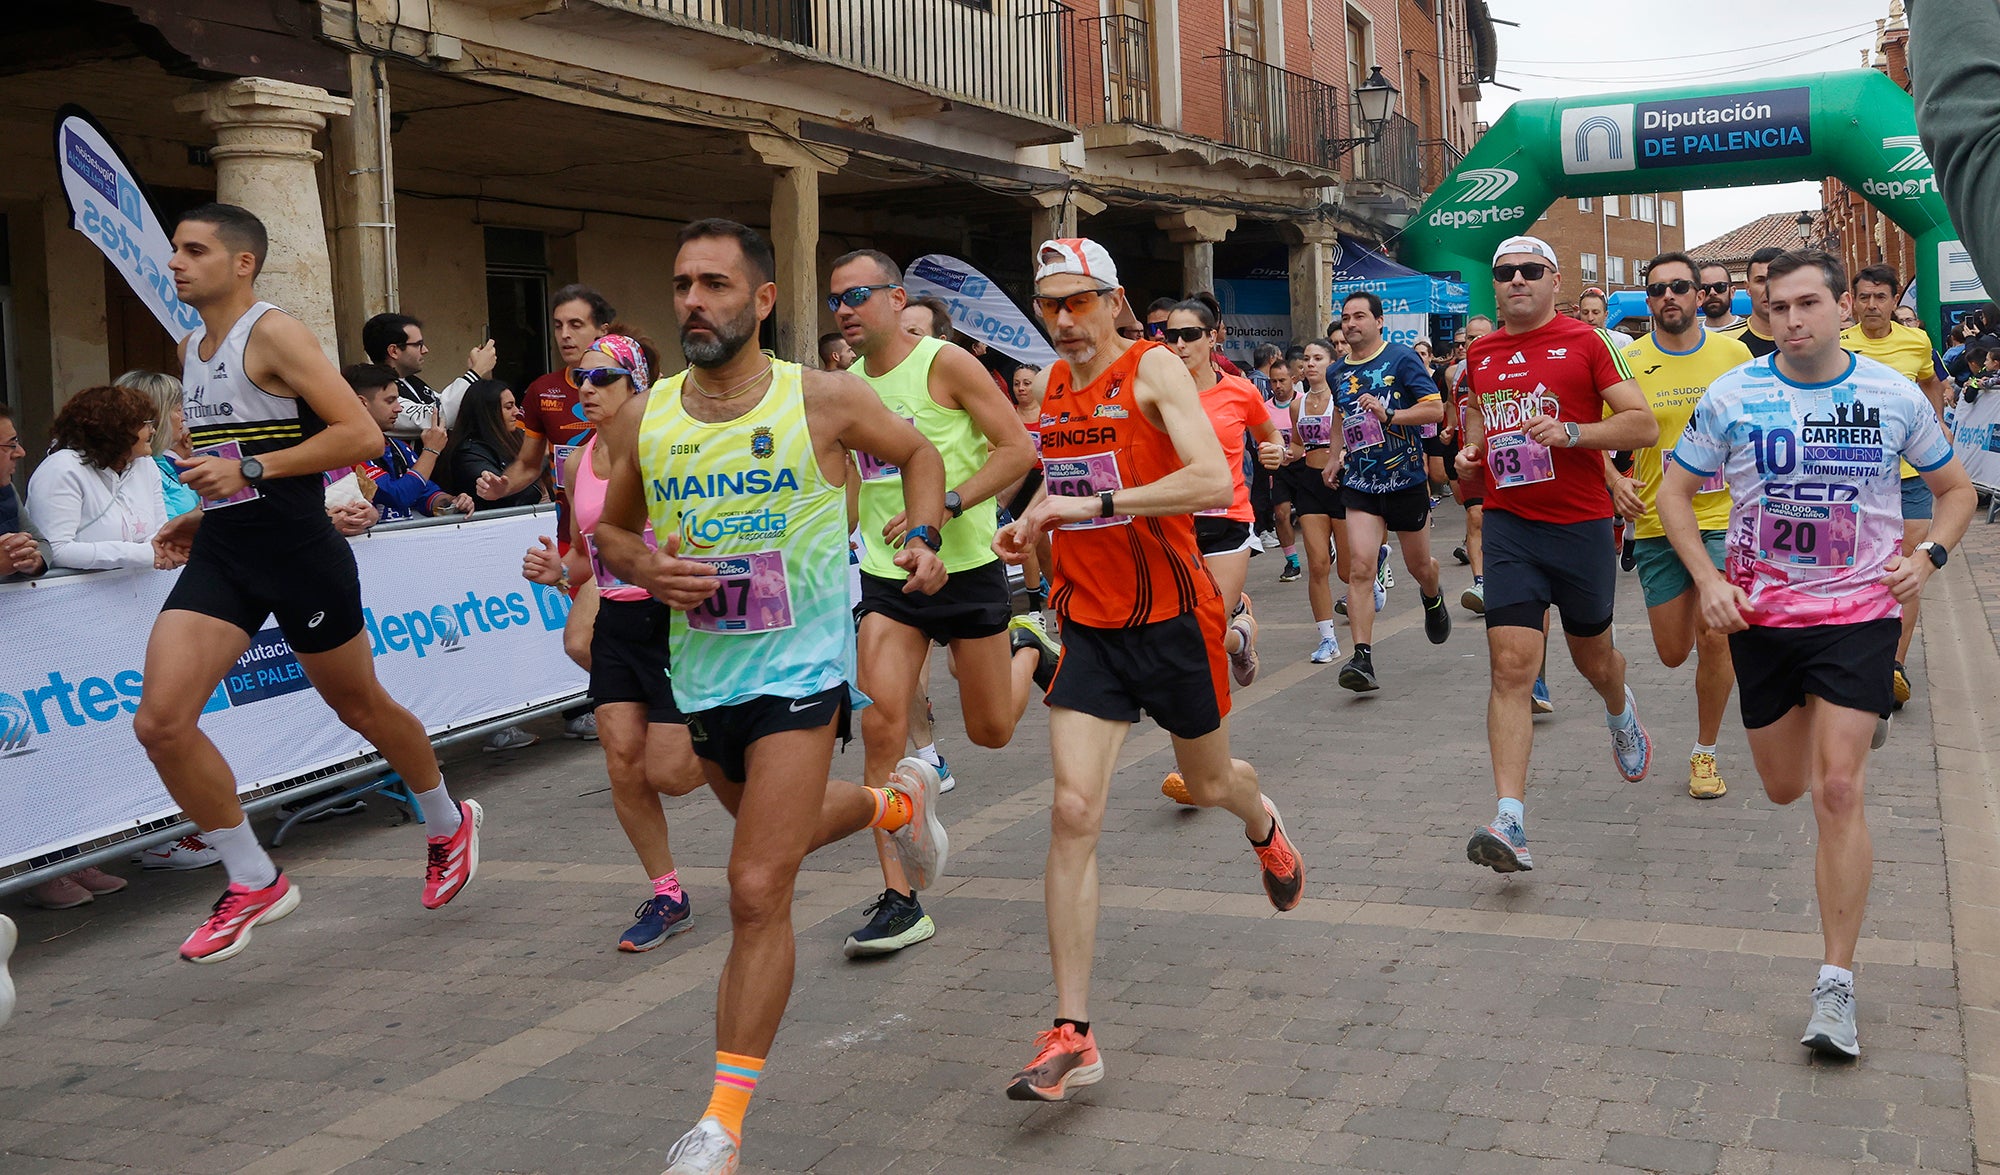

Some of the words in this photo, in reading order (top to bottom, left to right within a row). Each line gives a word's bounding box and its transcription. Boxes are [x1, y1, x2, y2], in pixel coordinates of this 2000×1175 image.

[1643, 101, 1771, 132] Diputación
[1644, 136, 1677, 157] DE
[1684, 126, 1804, 154] PALENCIA
[1862, 173, 1940, 199] deport
[1428, 205, 1525, 229] deportes
[1332, 281, 1387, 293] tación
[1226, 326, 1284, 338] Diputación
[1225, 341, 1240, 350] DE
[1507, 371, 1528, 379] ZURICH
[1482, 389, 1513, 406] SIENTE
[1656, 390, 1670, 398] sin
[1673, 386, 1707, 396] SUDOR
[1667, 399, 1683, 407] hay
[1685, 396, 1701, 404] VIC
[1041, 427, 1117, 448] REINOSA
[1299, 424, 1321, 439] 132
[1347, 425, 1364, 444] 56
[1802, 428, 1883, 445] CARRERA
[671, 443, 700, 455] GOBIK
[1749, 428, 1796, 475] 10
[1805, 447, 1882, 460] NOCTURNA
[1494, 448, 1521, 476] 63
[1803, 464, 1880, 477] MONUMENTAL
[653, 468, 798, 501] MAINSA
[1781, 503, 1811, 514] 10.000
[1773, 519, 1816, 553] 20
[695, 579, 750, 617] 07
[237, 638, 294, 668] putaci
[230, 673, 255, 693] DE
[256, 662, 303, 687] PALEN
[0, 670, 144, 742] ortes
